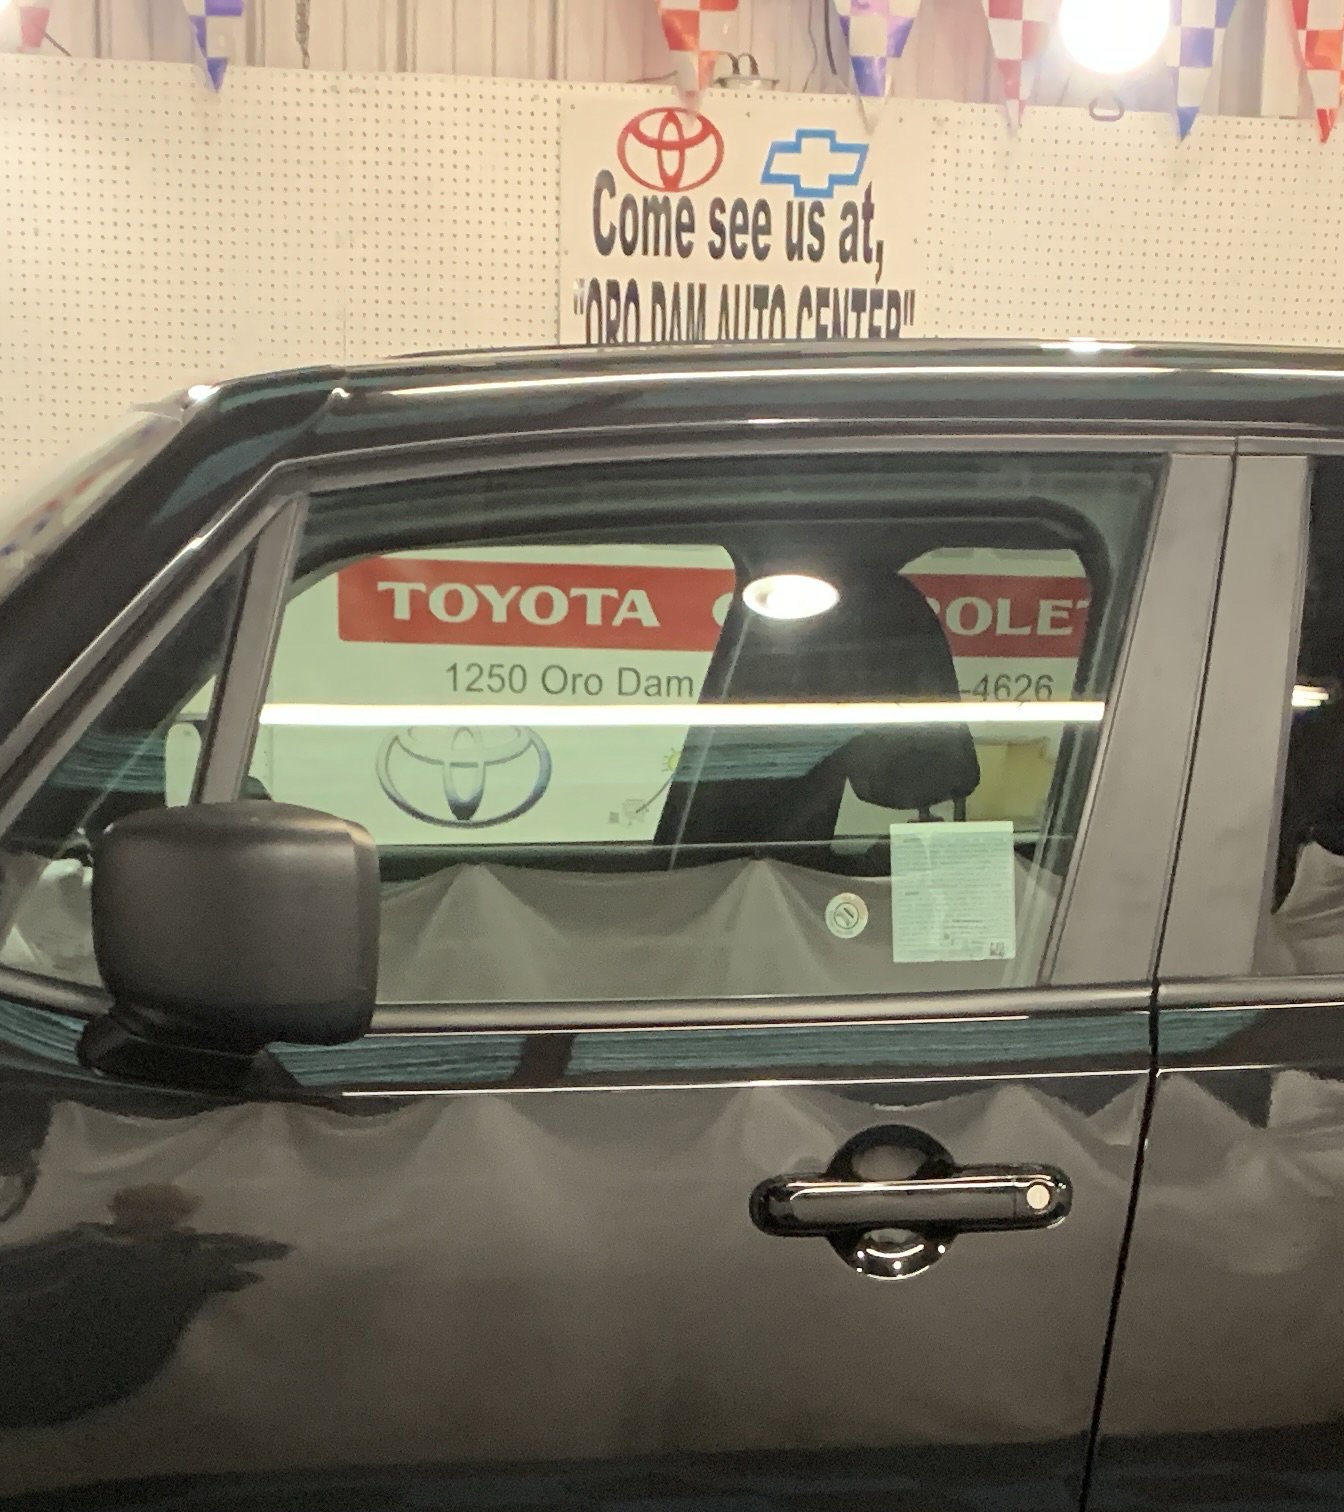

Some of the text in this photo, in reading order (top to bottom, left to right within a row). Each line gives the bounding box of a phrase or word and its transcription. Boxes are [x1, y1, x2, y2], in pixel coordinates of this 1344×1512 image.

[593, 169, 885, 285] Come see us at,
[377, 581, 661, 628] TOYOTA
[445, 661, 694, 698] 1250 Oro Dam
[960, 673, 1055, 701] -4626
